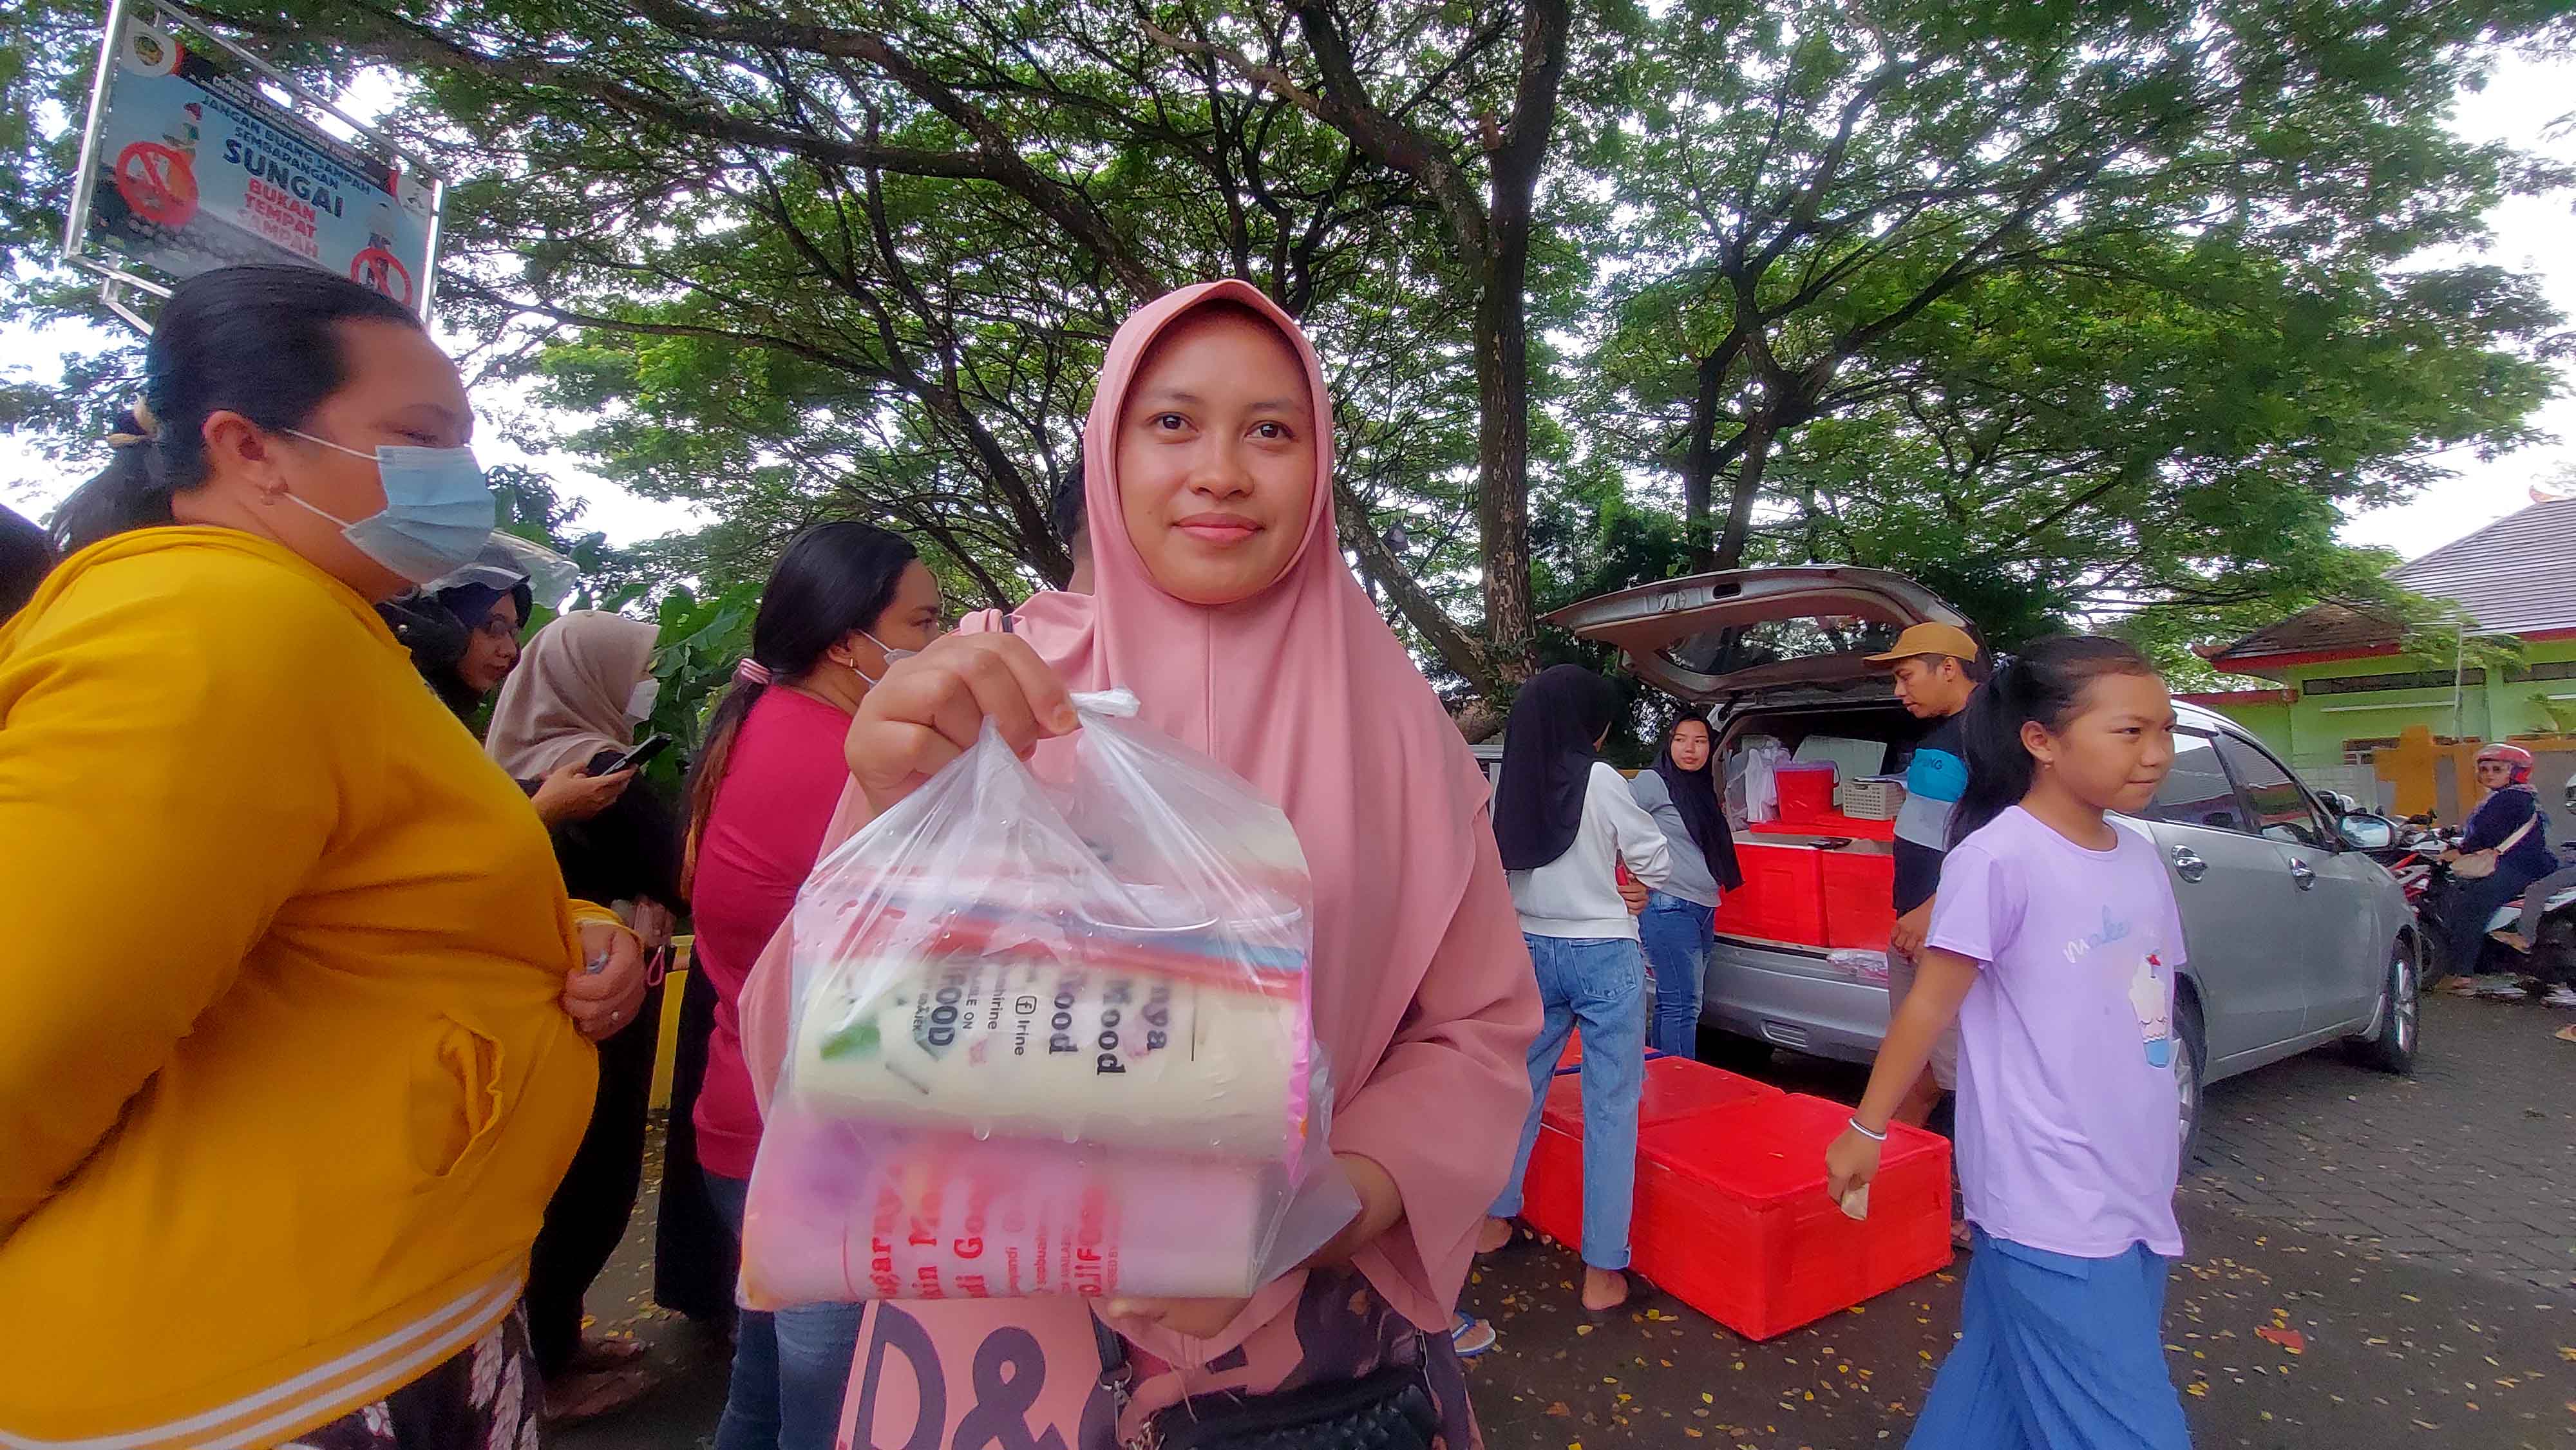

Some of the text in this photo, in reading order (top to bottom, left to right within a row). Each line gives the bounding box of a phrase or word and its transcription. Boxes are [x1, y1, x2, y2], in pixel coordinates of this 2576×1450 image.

[213, 75, 251, 103] DINAS
[202, 95, 261, 133] JANGAN
[265, 129, 313, 162] BUANG
[318, 158, 370, 194] SAMPAH
[235, 126, 338, 190] SEMBARANGAN
[223, 138, 343, 217] SUNGAI
[249, 178, 317, 220] BUKAN
[238, 207, 319, 258] SAMPAH
[244, 191, 316, 238] TEMPAT
[963, 1012, 974, 1030] ON
[1014, 1020, 1031, 1056] Irine
